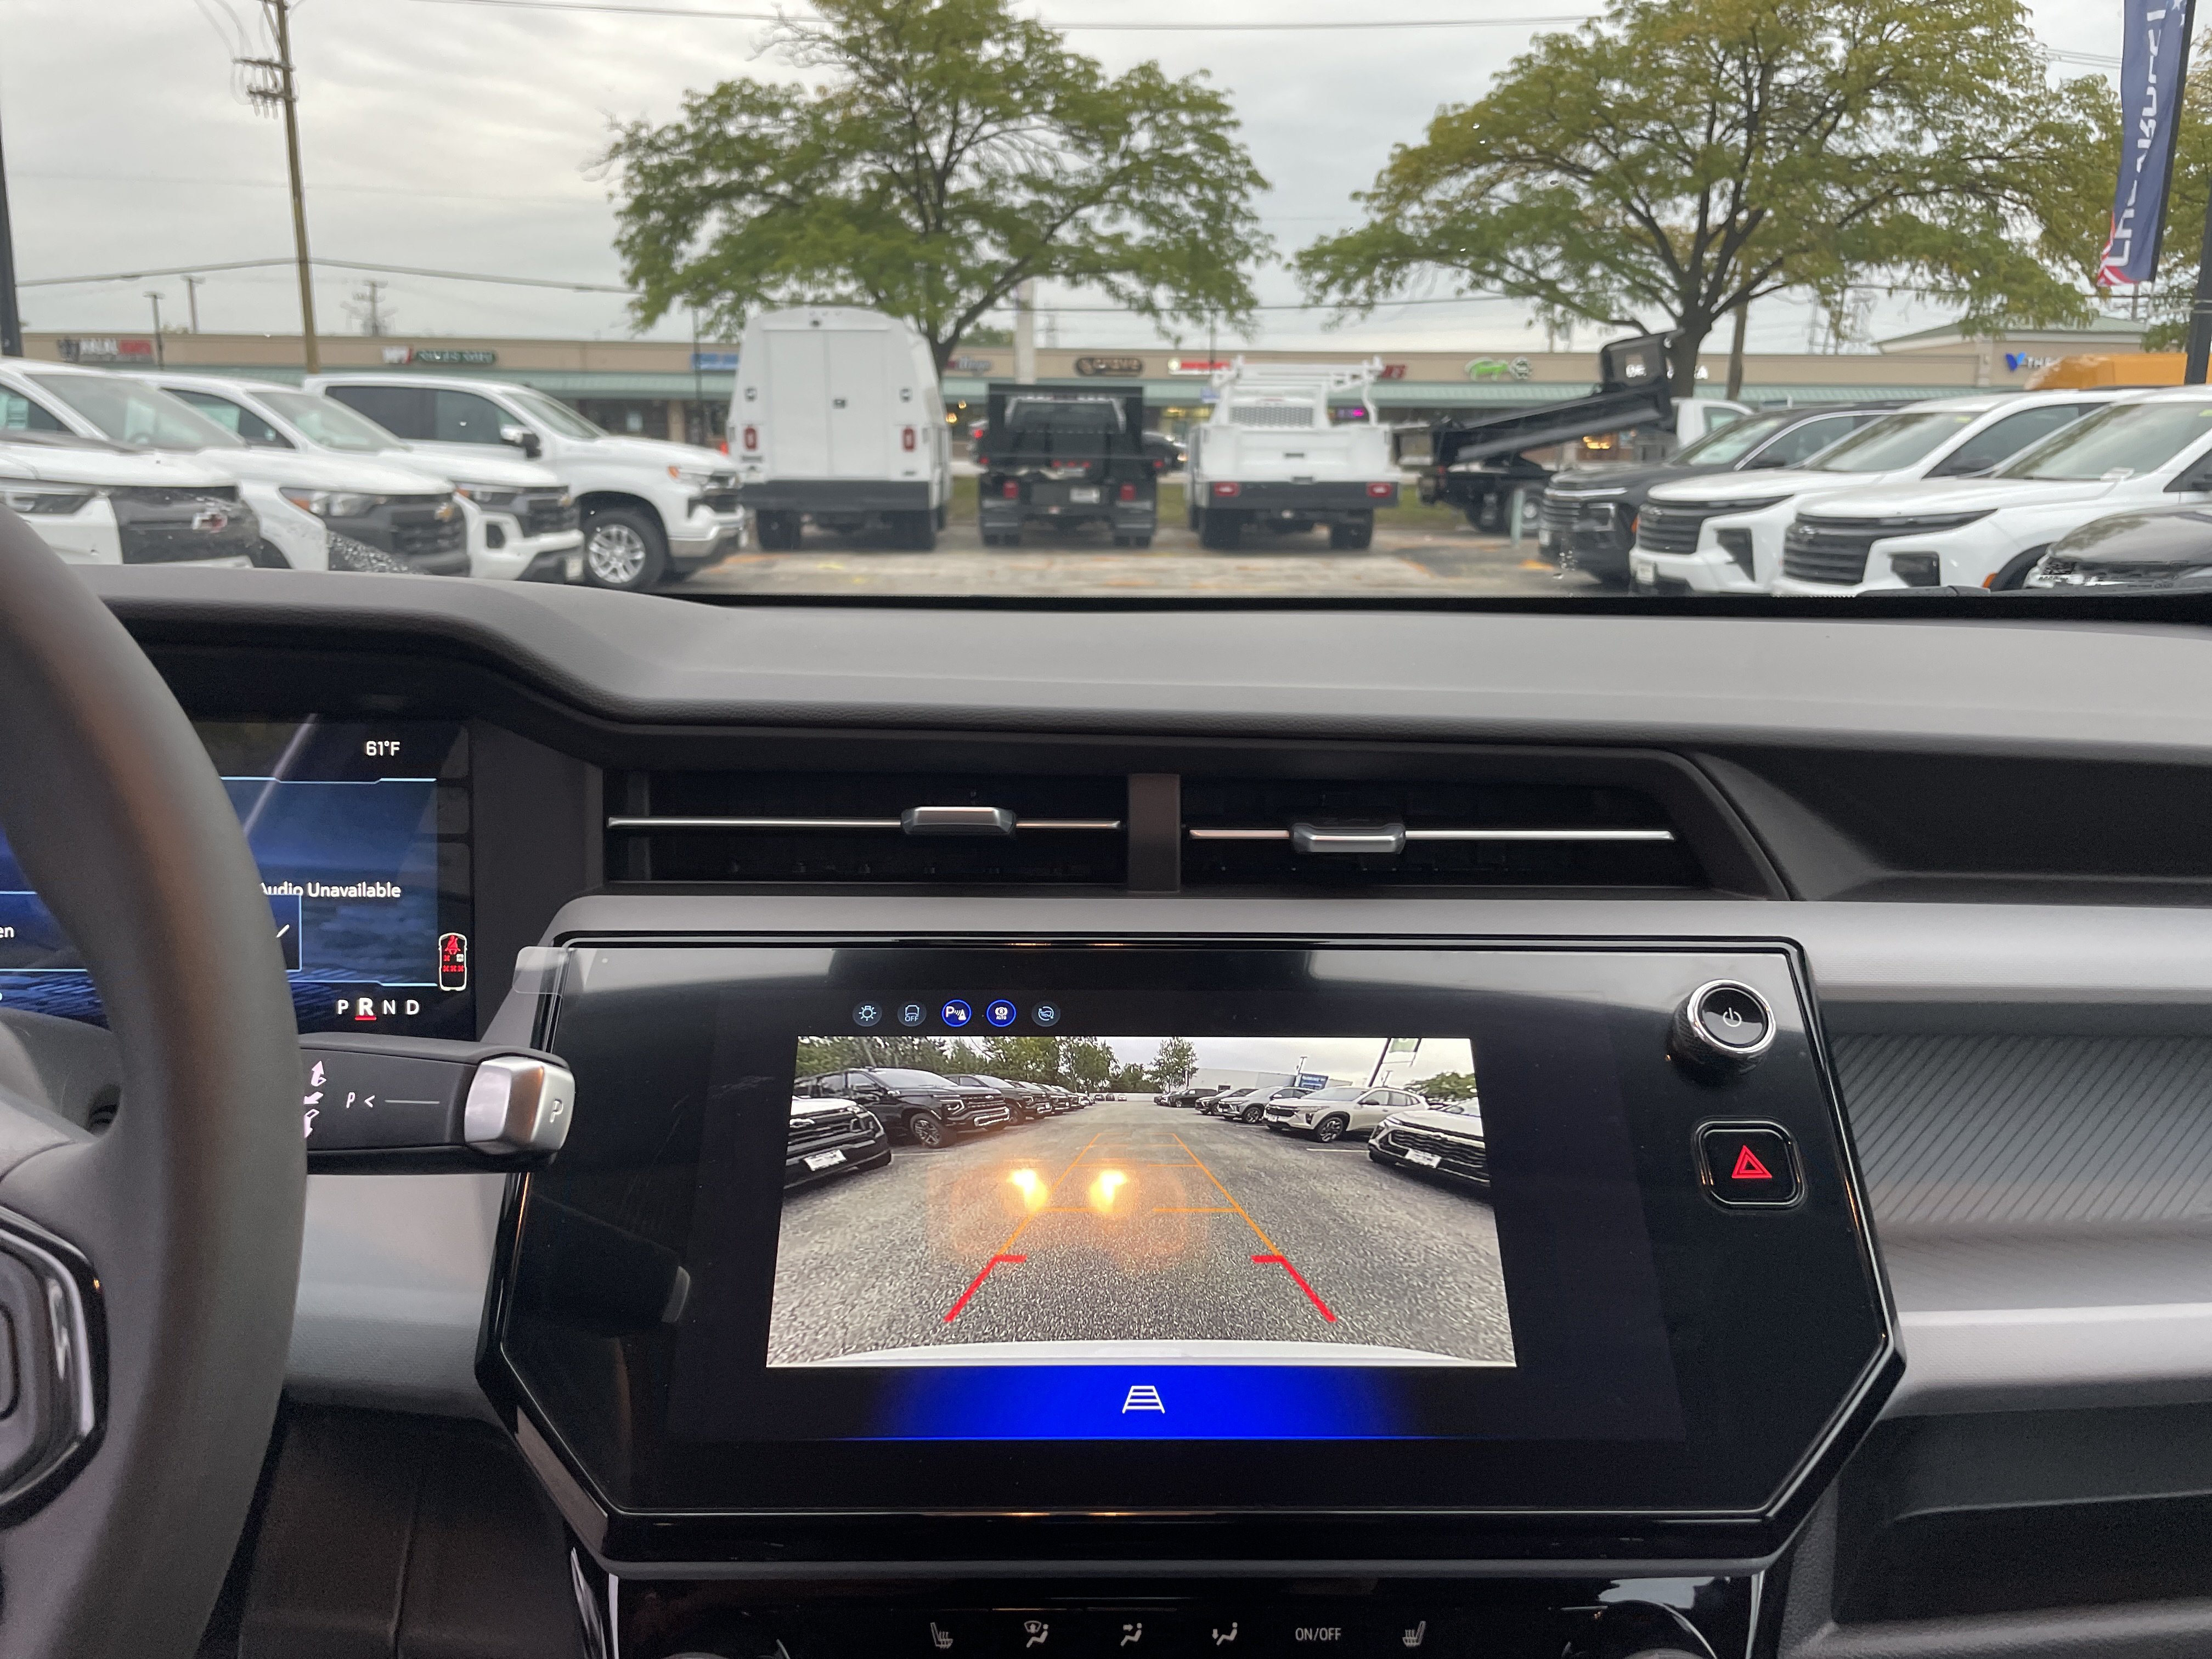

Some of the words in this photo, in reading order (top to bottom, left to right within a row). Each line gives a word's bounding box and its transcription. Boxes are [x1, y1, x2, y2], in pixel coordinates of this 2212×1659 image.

[366, 741, 400, 756] 61°F
[308, 882, 401, 898] Unavailable
[338, 999, 349, 1015] P
[359, 997, 374, 1016] R
[383, 999, 396, 1015] N
[407, 1000, 419, 1015] D
[1295, 1627, 1342, 1641] ON/OFF
